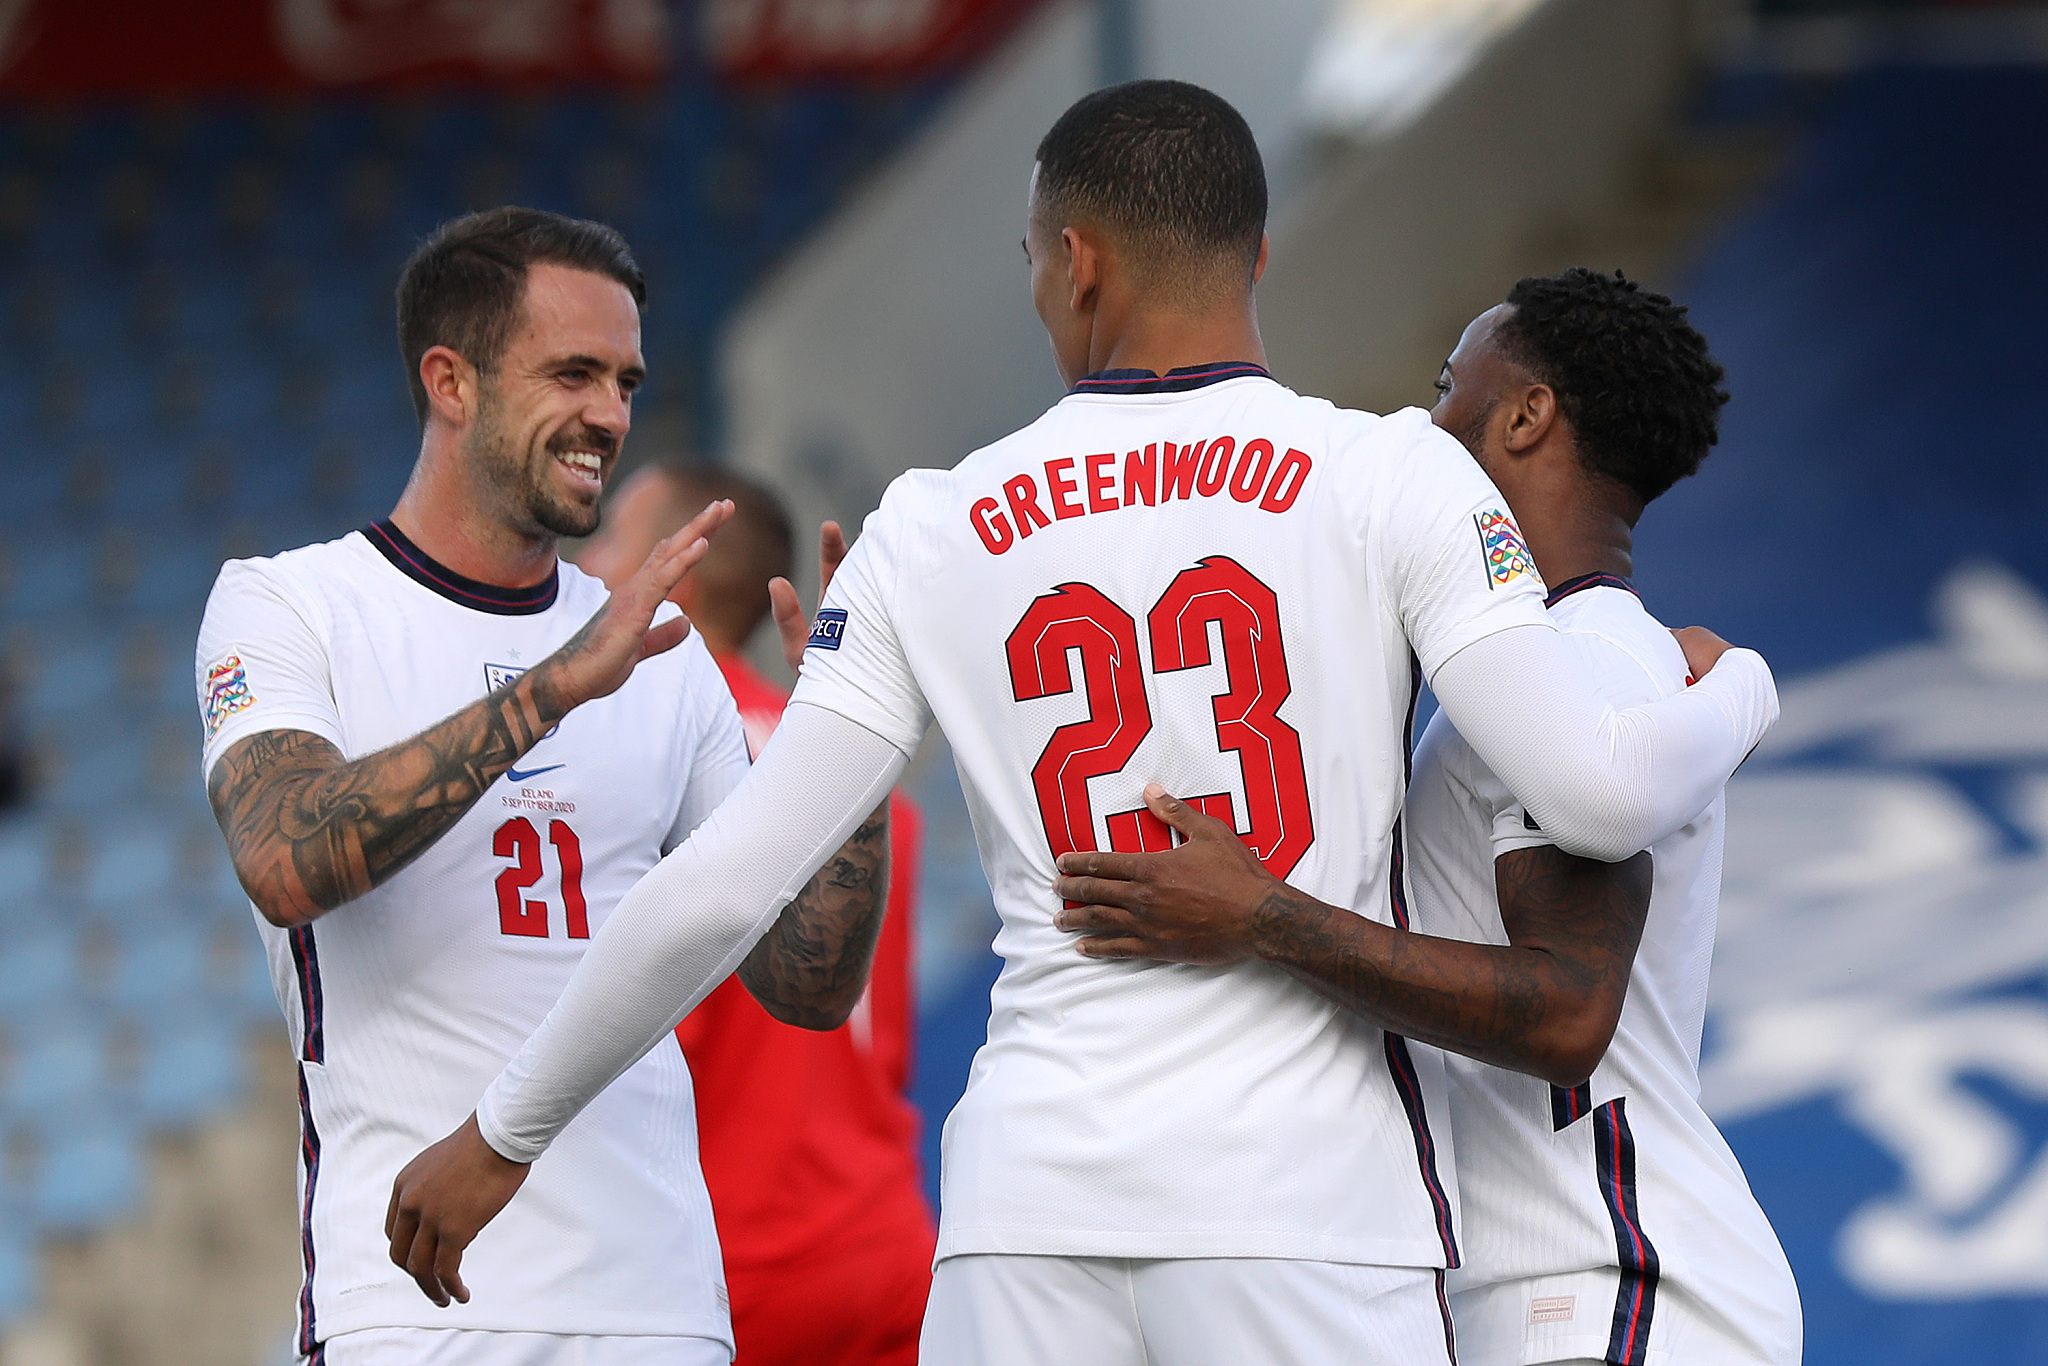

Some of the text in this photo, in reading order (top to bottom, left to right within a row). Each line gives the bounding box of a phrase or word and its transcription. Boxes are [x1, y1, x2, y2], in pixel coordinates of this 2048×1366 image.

[969, 435, 1312, 555] GREENWOOD
[1004, 555, 1315, 910] 23
[508, 798, 554, 811] SEPTEMBER
[554, 801, 577, 813] 2020
[521, 788, 555, 799] ICELAND
[492, 815, 590, 939] 21
